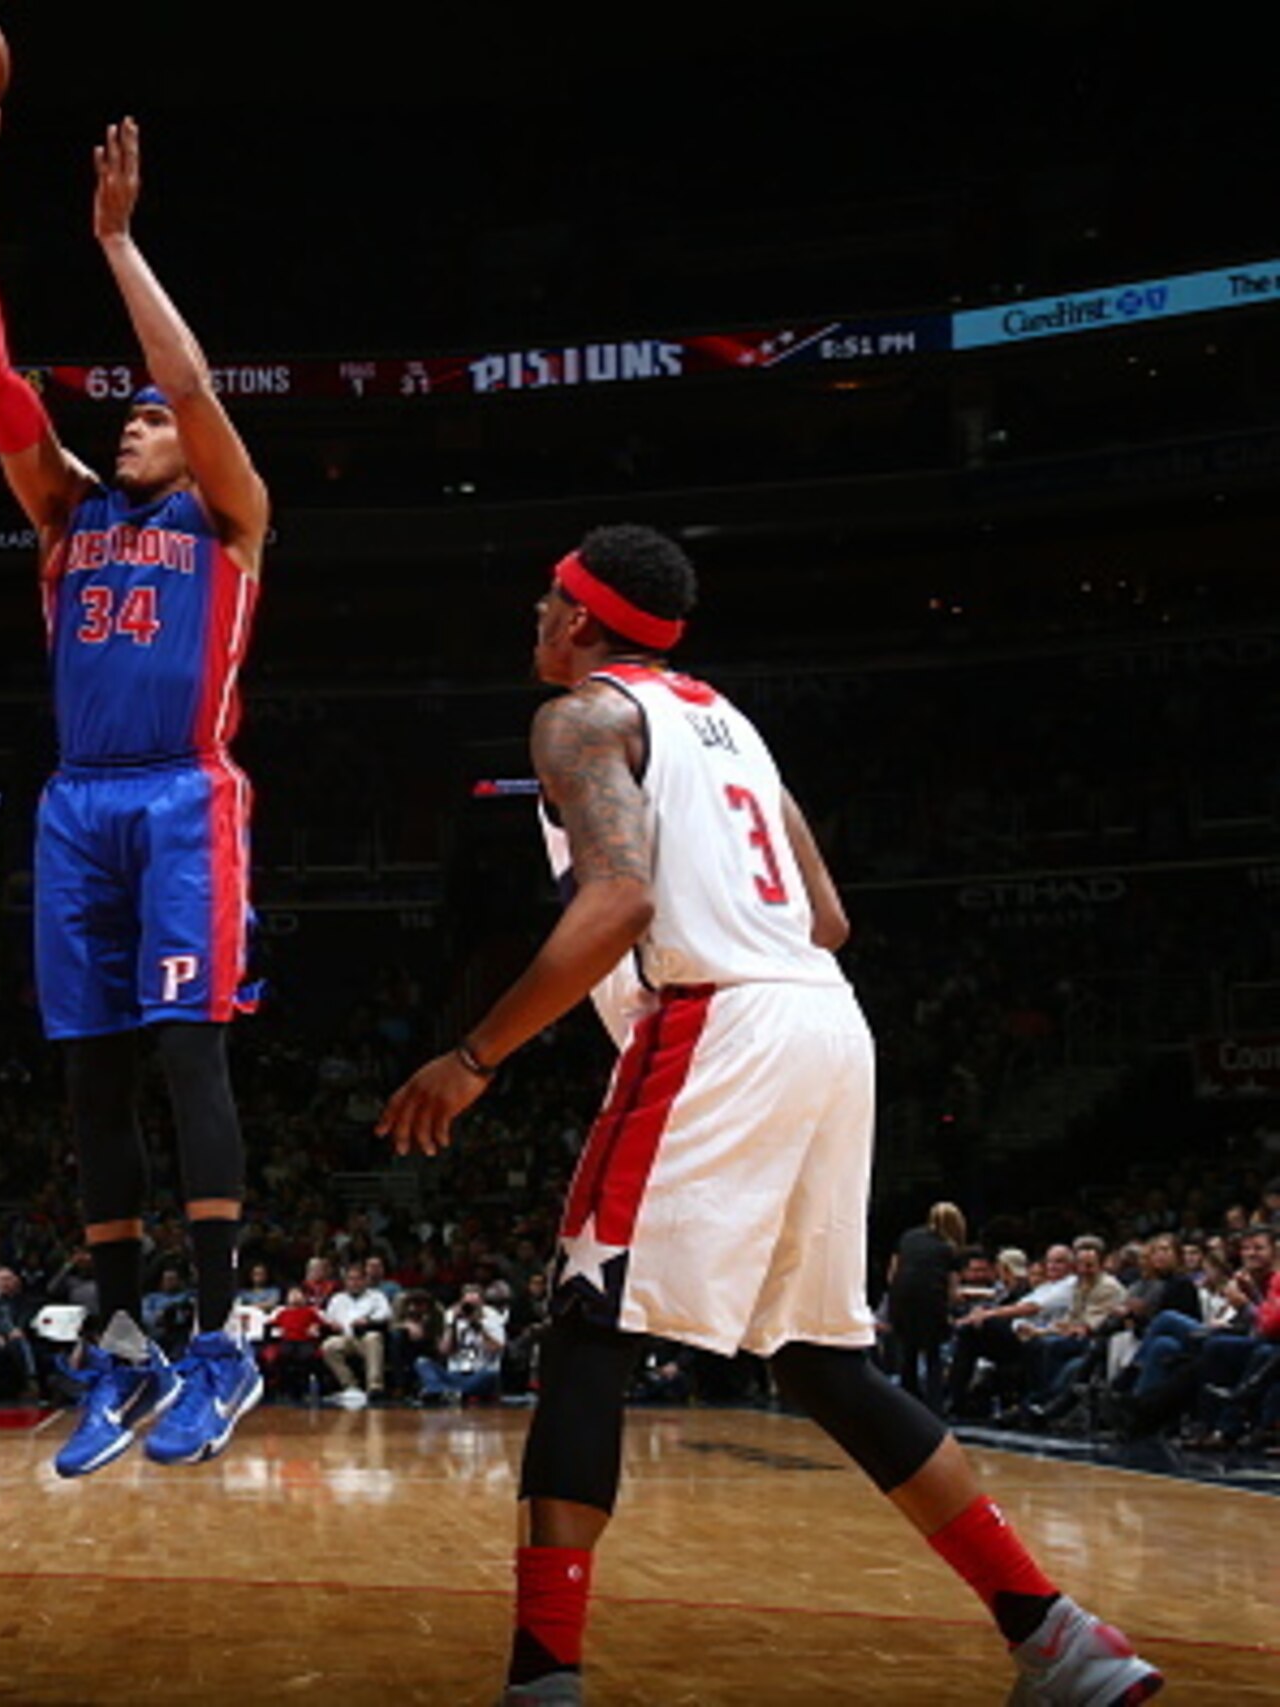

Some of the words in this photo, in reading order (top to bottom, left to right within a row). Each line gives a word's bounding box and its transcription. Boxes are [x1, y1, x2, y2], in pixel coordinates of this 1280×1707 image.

[1002, 297, 1113, 336] CareFirst
[85, 368, 134, 399] 63
[469, 339, 685, 394] PISTONS
[77, 585, 161, 646] 34
[724, 784, 788, 904] 3
[957, 876, 1126, 910] ETIHAD
[159, 956, 198, 1002] P
